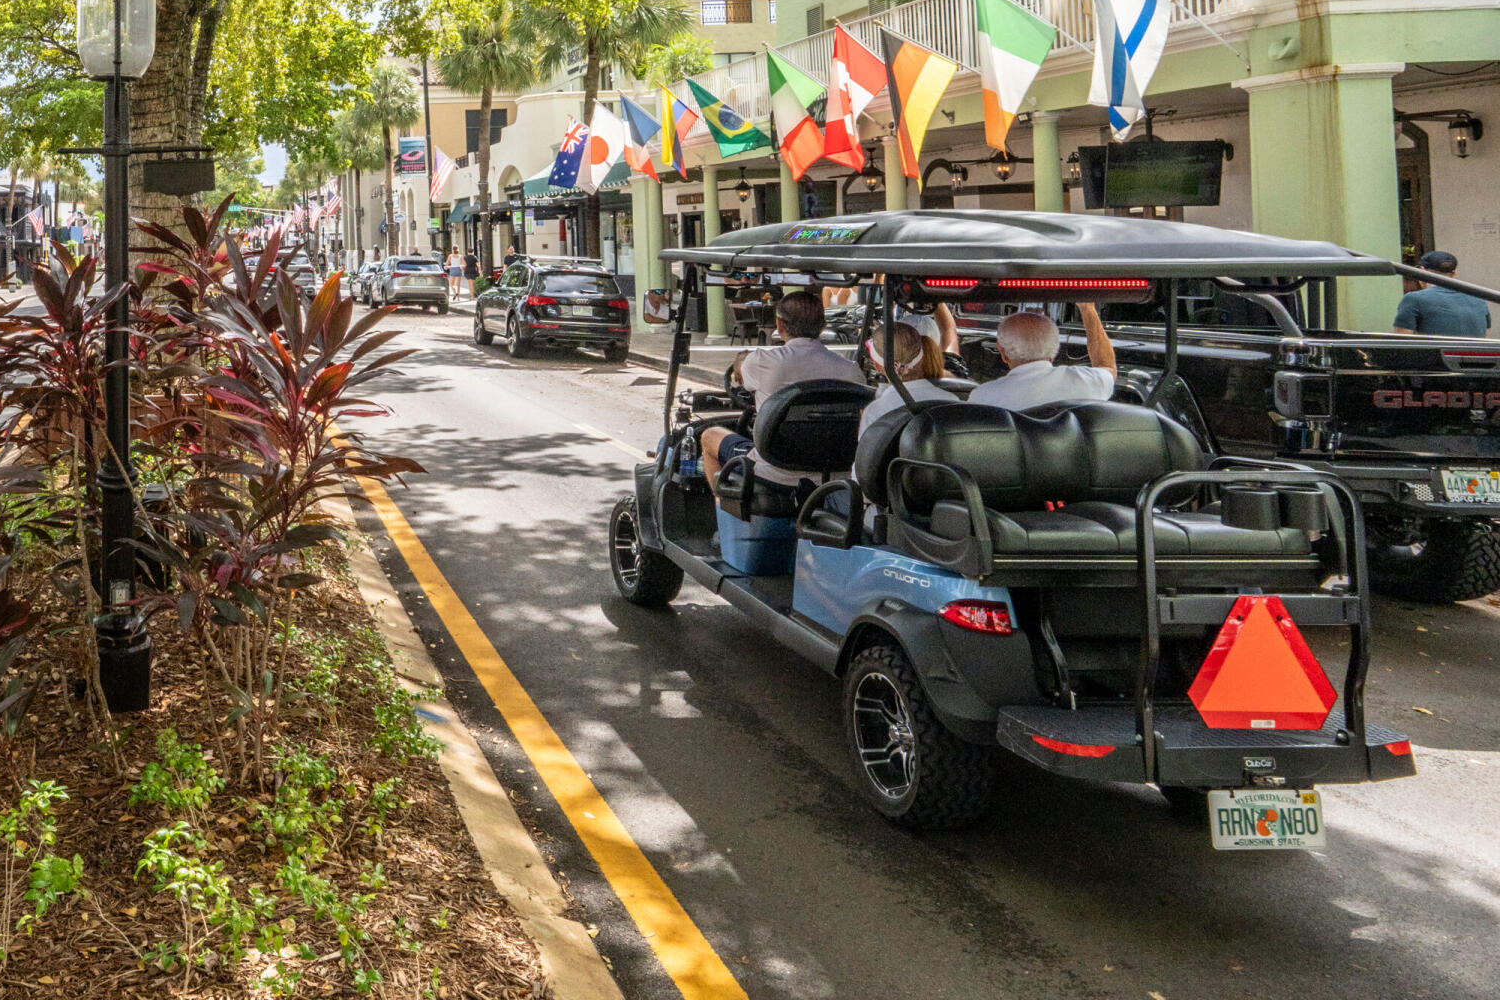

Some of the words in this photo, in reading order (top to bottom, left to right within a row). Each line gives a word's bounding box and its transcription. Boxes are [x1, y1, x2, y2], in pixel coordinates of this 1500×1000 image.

[883, 567, 931, 588] onward
[1245, 759, 1261, 768] Club
[1261, 759, 1273, 768] Car
[1217, 807, 1257, 837] RRN
[1239, 838, 1275, 847] SUNSHINE
[1278, 838, 1301, 846] STATE
